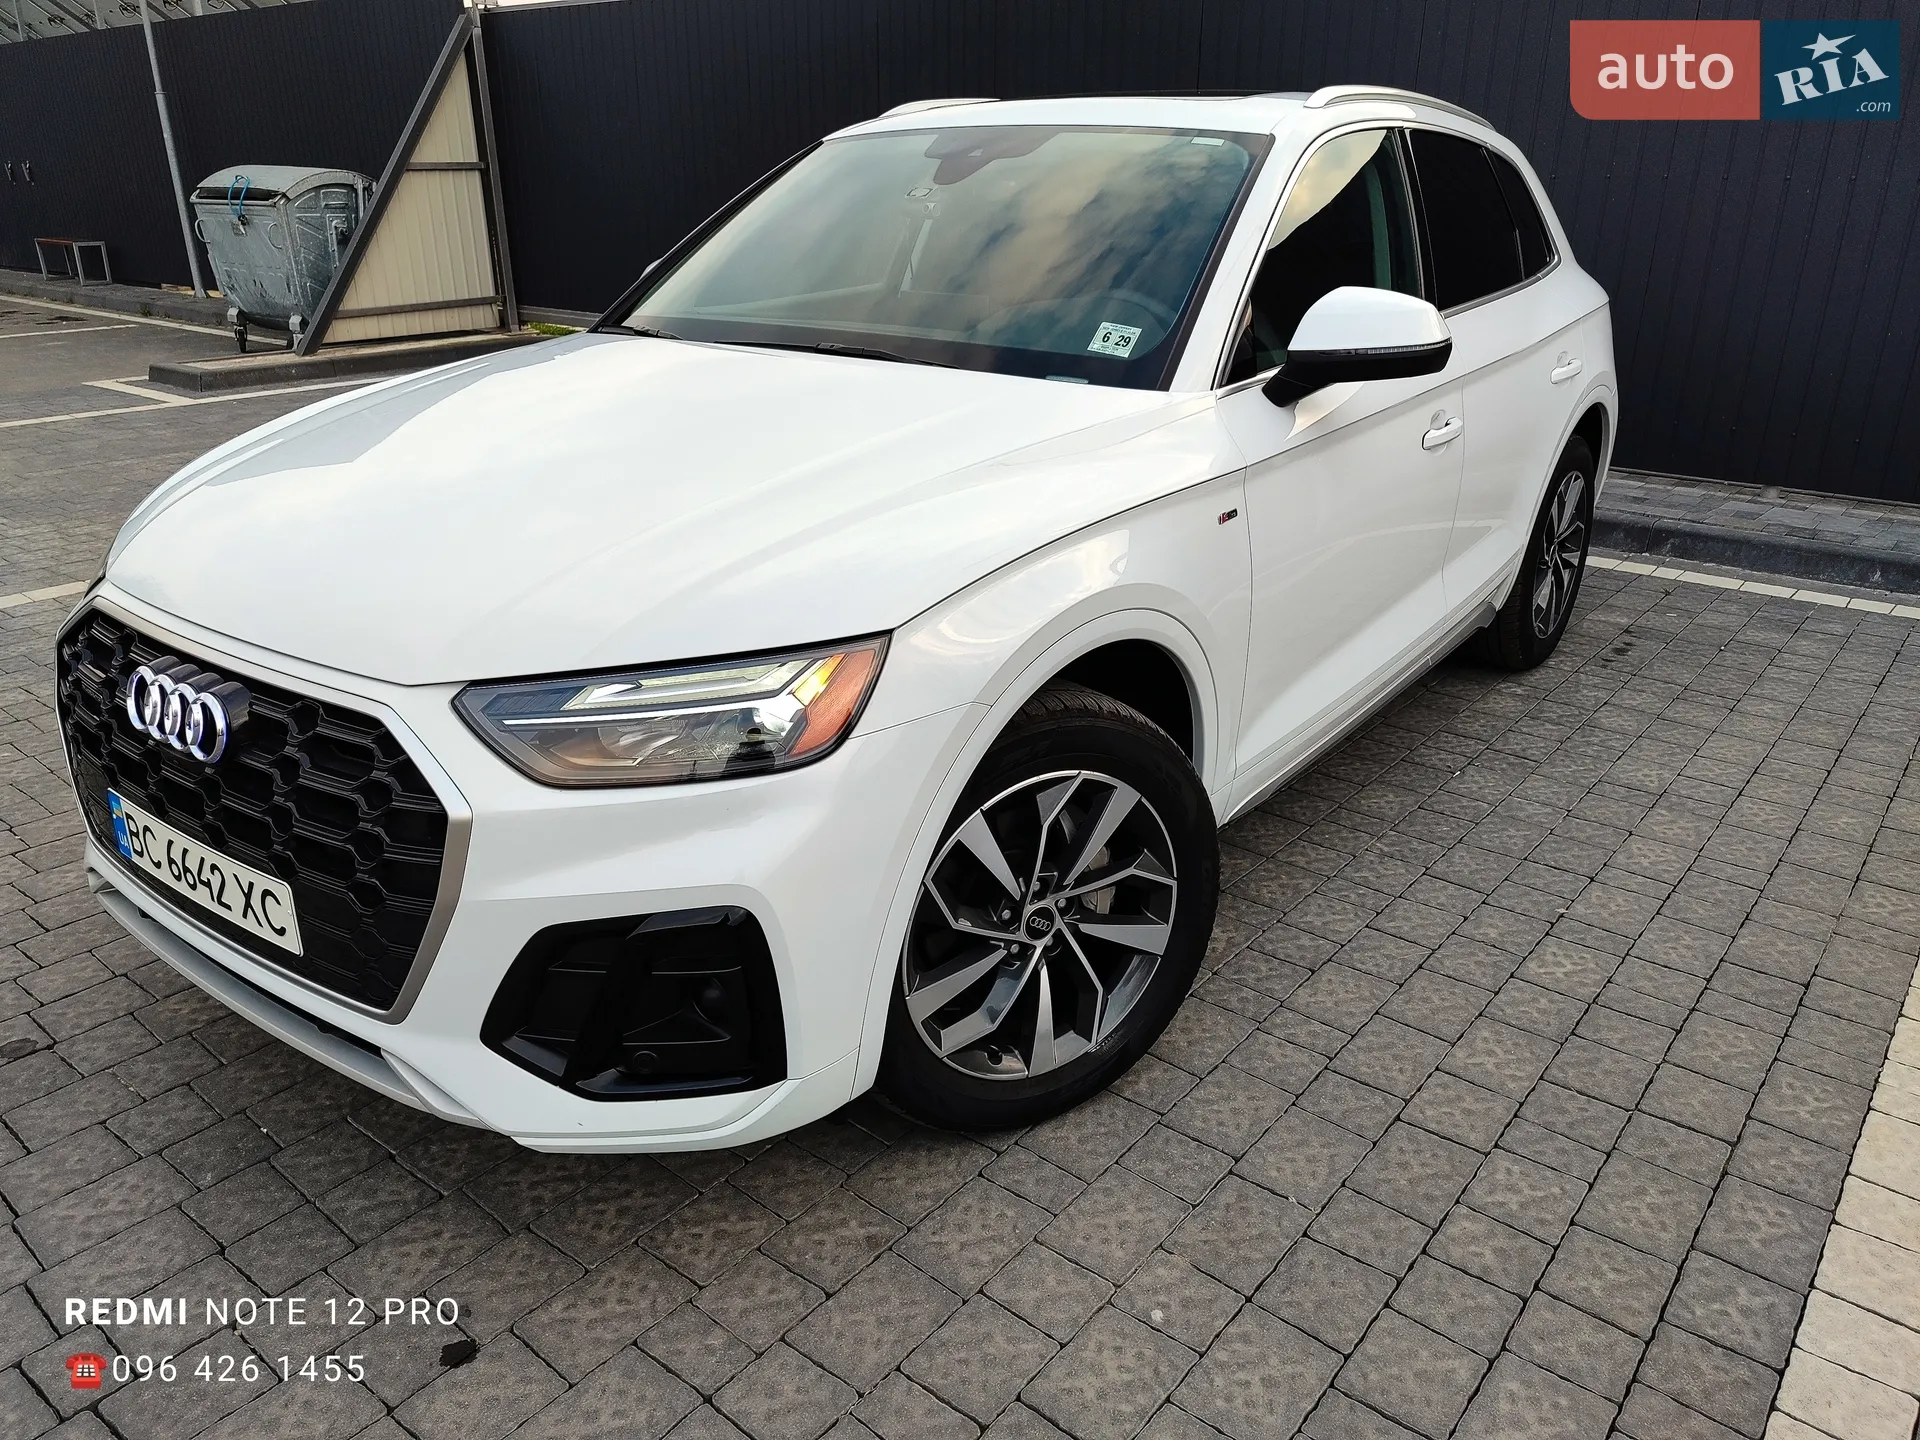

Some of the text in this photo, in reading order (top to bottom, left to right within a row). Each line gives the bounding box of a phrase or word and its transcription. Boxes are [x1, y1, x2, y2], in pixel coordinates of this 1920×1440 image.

[1102, 331, 1131, 347] 6 29
[119, 832, 129, 848] UA
[125, 812, 287, 937] BC 6642 XC
